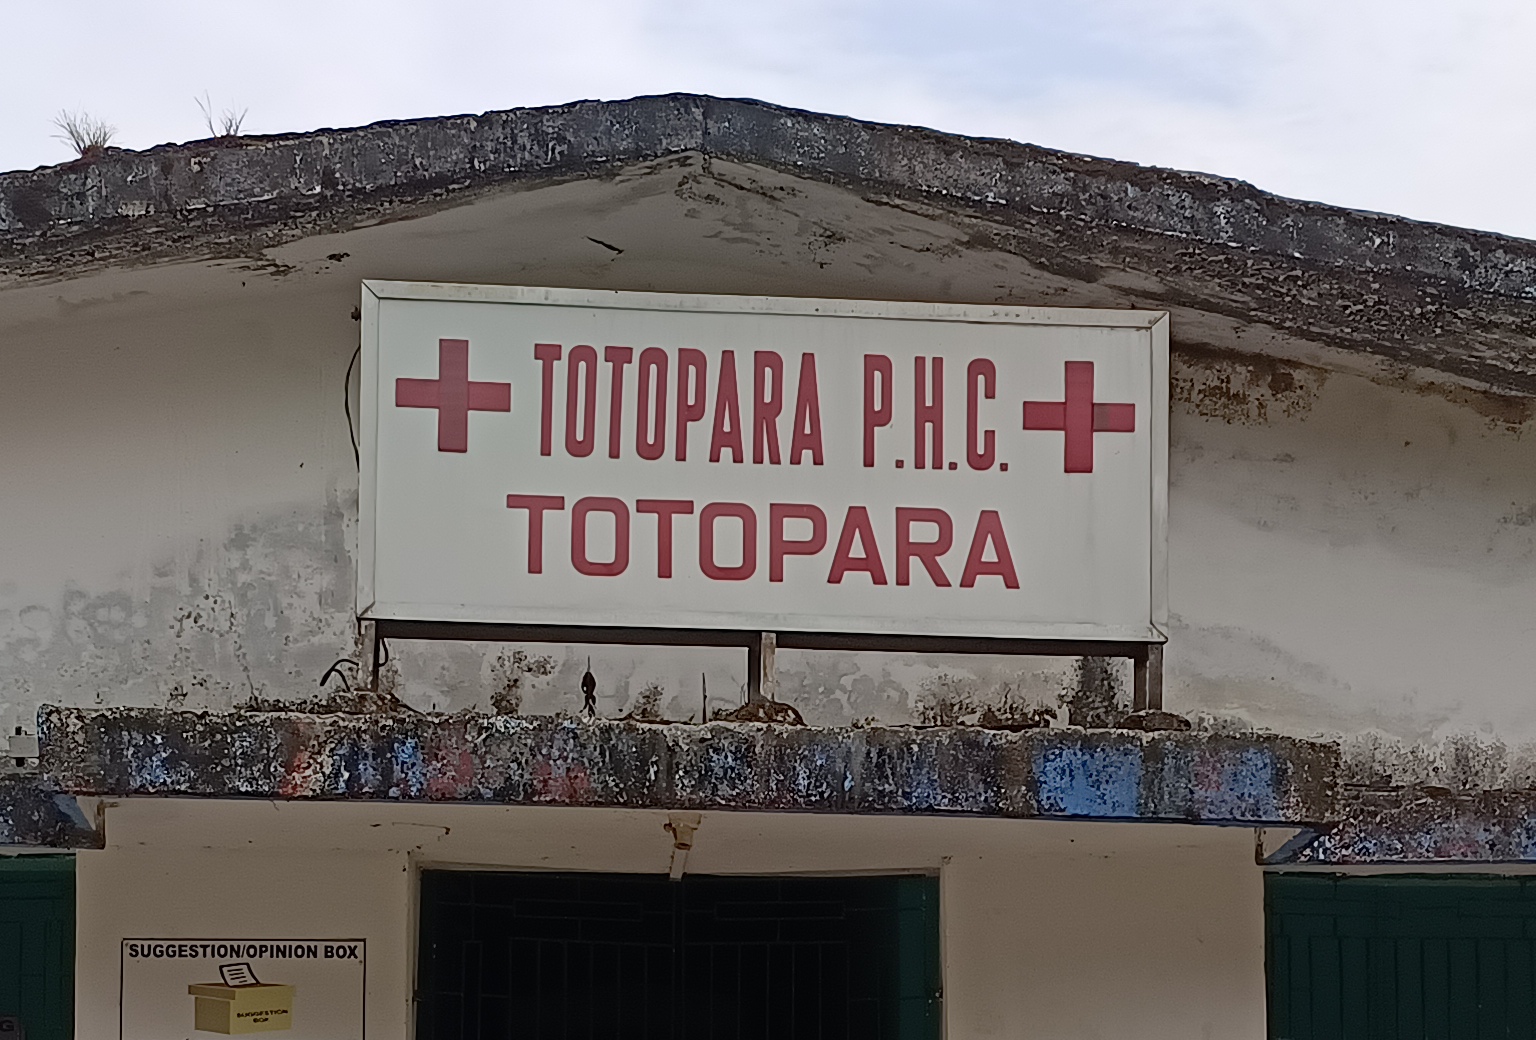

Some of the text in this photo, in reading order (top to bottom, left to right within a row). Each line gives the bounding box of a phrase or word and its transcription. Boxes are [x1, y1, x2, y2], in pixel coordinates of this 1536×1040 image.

[534, 342, 1009, 472] TOTOPARA P.H.C.
[505, 493, 1021, 590] TOTOPARA
[128, 943, 359, 960] SUGGESTION/OPINION BOX
